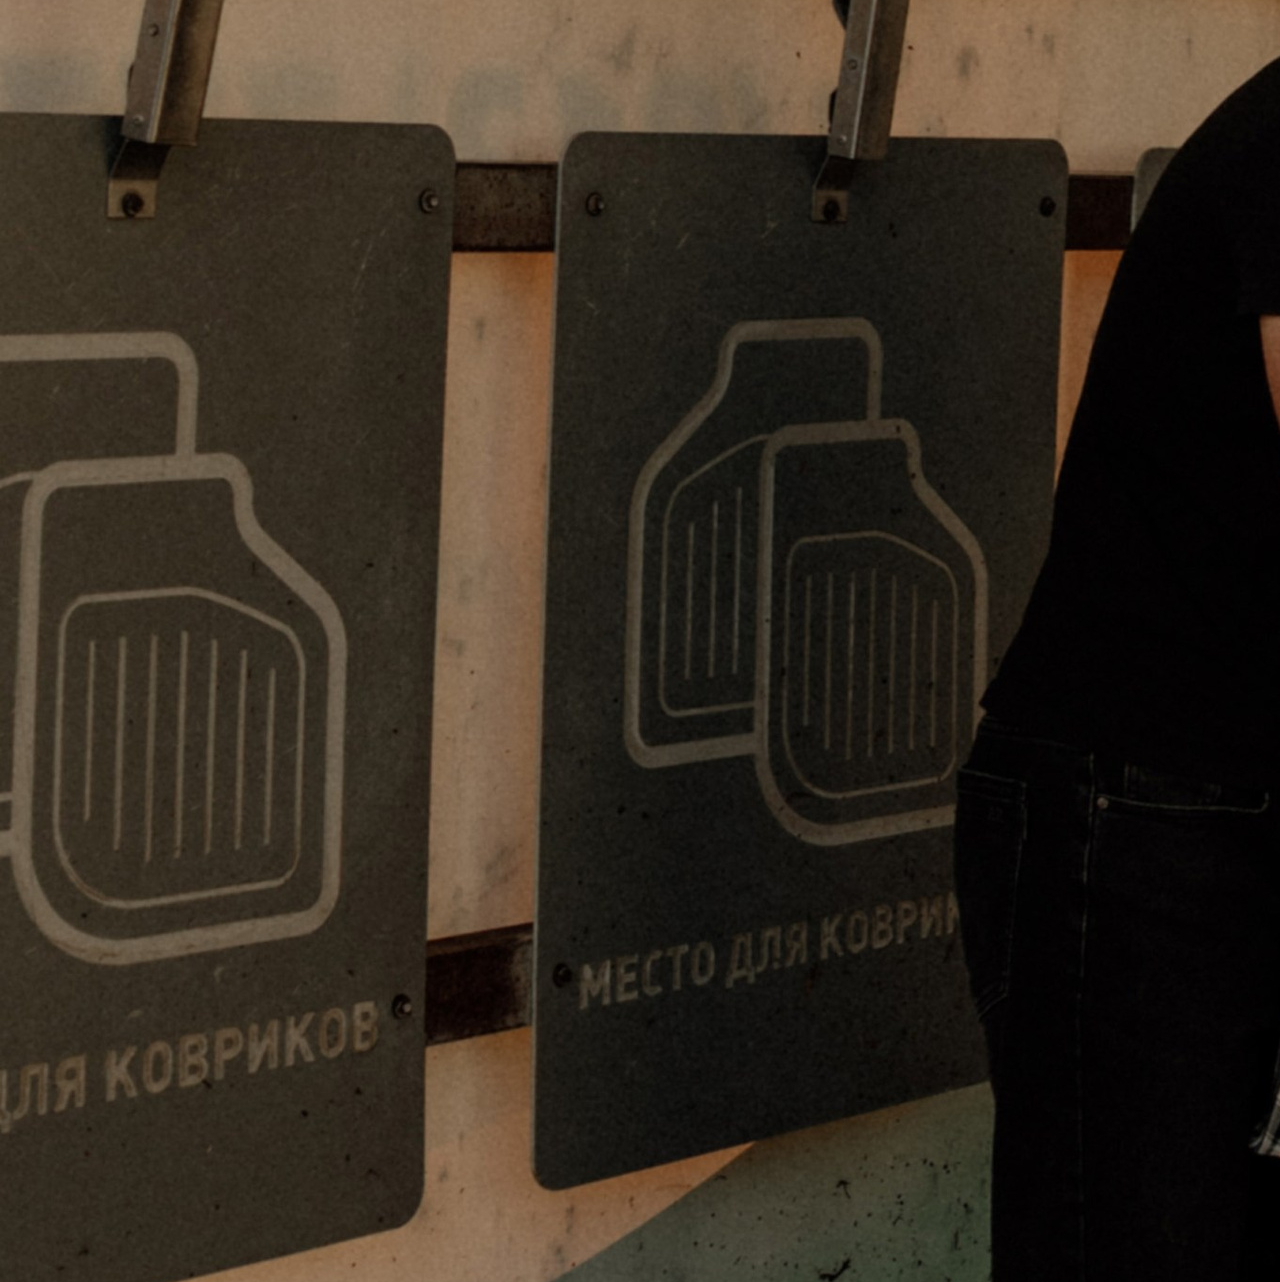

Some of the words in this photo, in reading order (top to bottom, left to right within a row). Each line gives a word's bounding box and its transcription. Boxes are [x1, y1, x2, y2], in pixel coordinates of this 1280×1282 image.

[579, 940, 716, 1011] МЕСТО
[723, 919, 808, 990] ДЛЯ
[818, 890, 960, 961] КОВРИ
[104, 1000, 381, 1103] КОВРИКОВ
